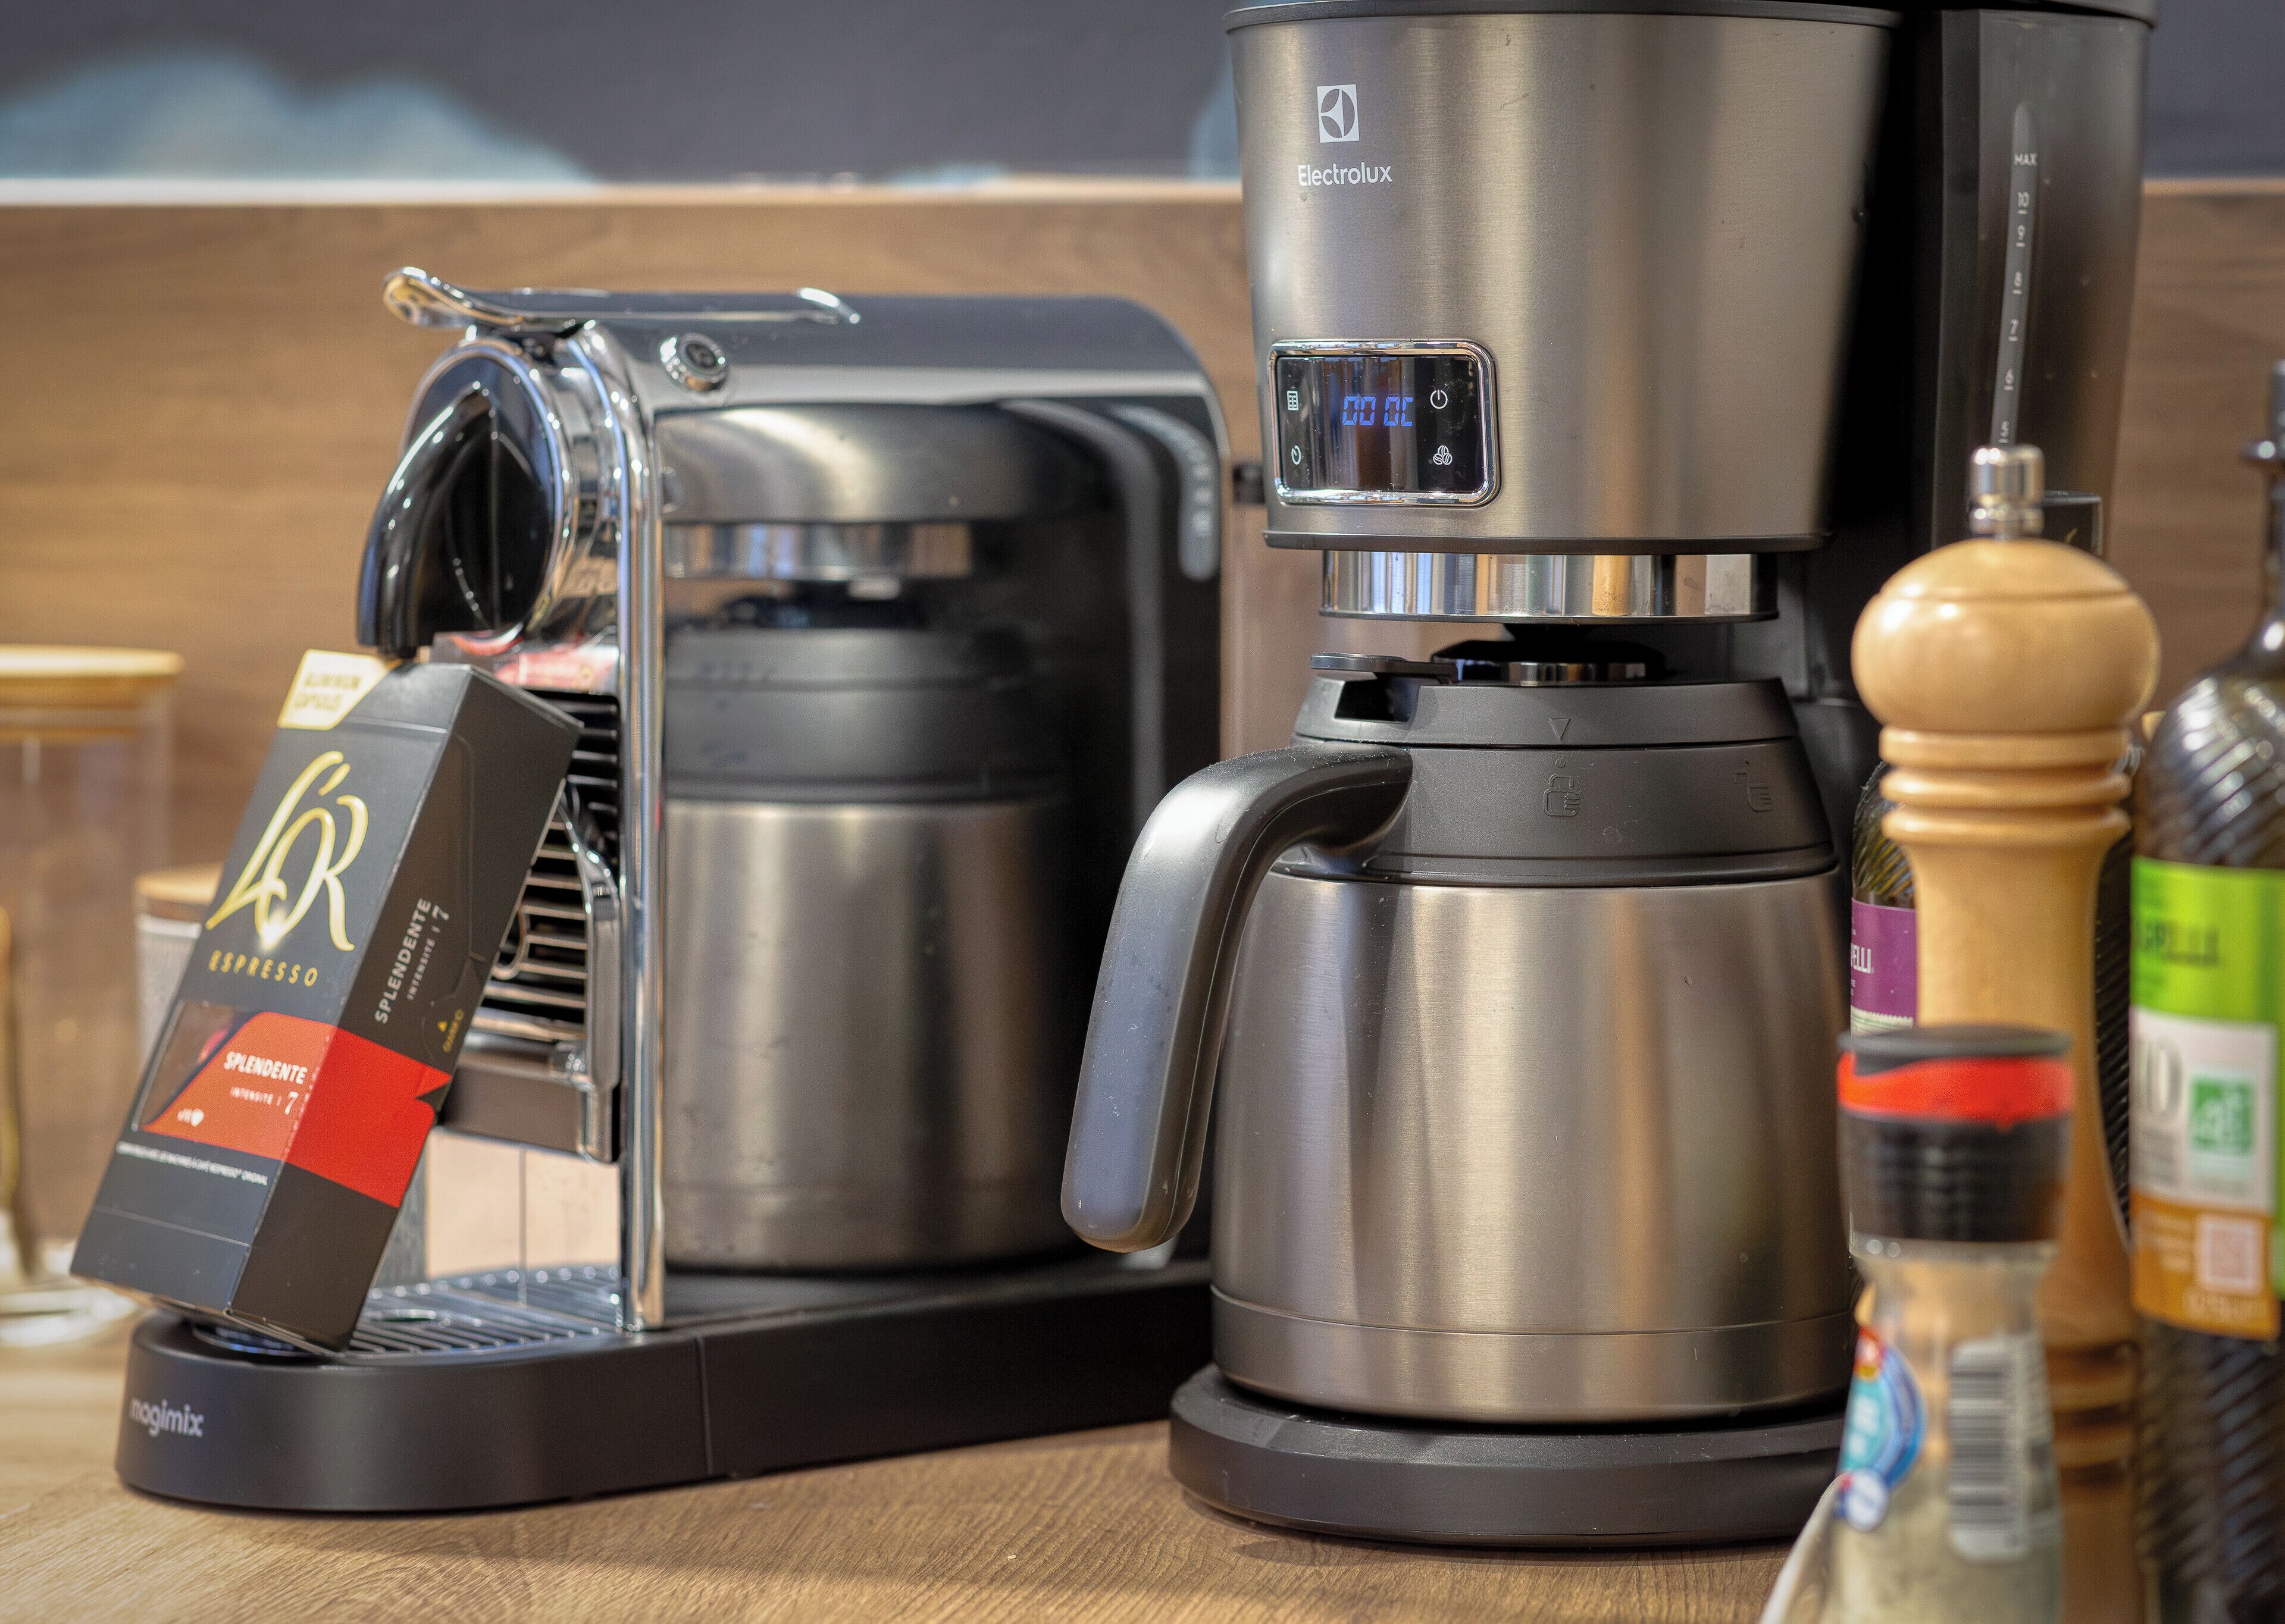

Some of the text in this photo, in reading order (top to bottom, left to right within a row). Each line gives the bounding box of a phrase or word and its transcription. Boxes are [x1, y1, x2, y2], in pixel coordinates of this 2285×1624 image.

[2014, 153, 2037, 166] MAX
[1298, 161, 1393, 187] Electrolux
[2018, 192, 2030, 208] 10
[2017, 225, 2026, 240] 9
[2010, 319, 2019, 335] 7
[431, 904, 449, 920] 7
[208, 950, 318, 987] ESPRESSO
[374, 898, 431, 1024] SPLENDENTE
[223, 1051, 308, 1084] SPLENDENTE
[284, 1091, 299, 1115] 7
[130, 1397, 204, 1438] magimix
